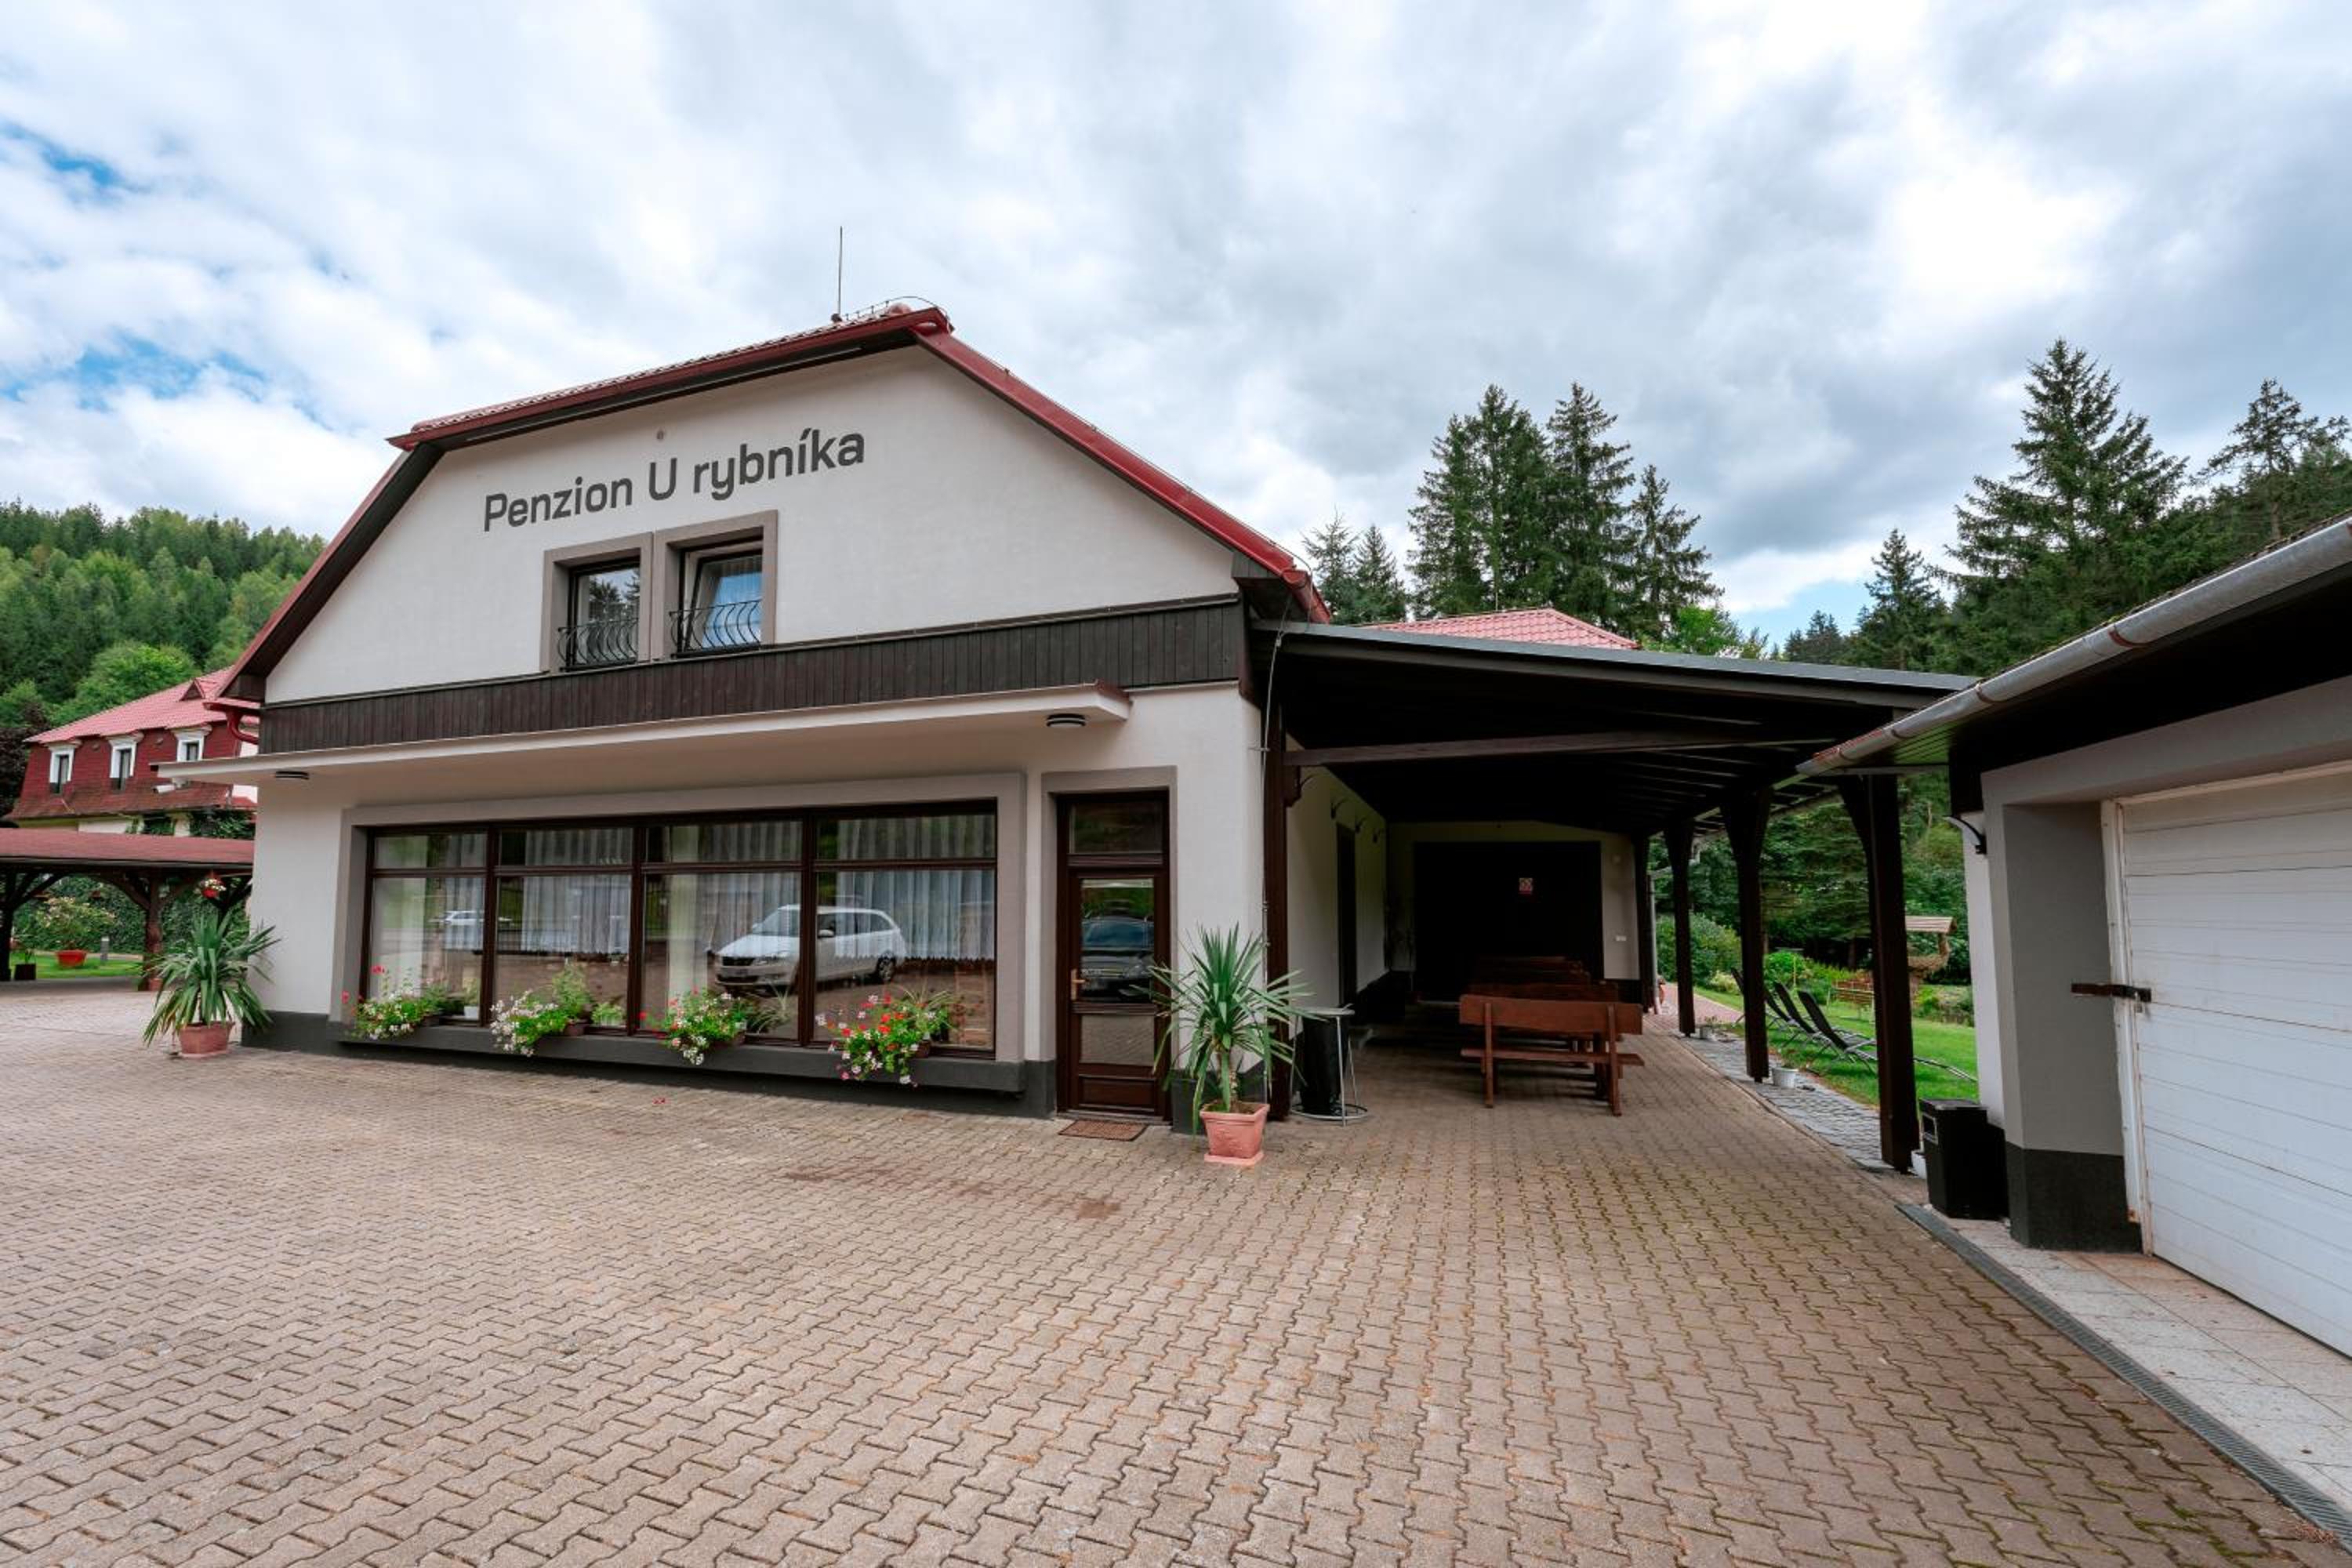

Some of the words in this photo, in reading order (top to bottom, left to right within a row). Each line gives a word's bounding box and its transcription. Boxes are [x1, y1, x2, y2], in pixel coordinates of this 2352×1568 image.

[484, 476, 633, 532] Penzion
[648, 457, 677, 501] U
[693, 427, 865, 501] rybníka
